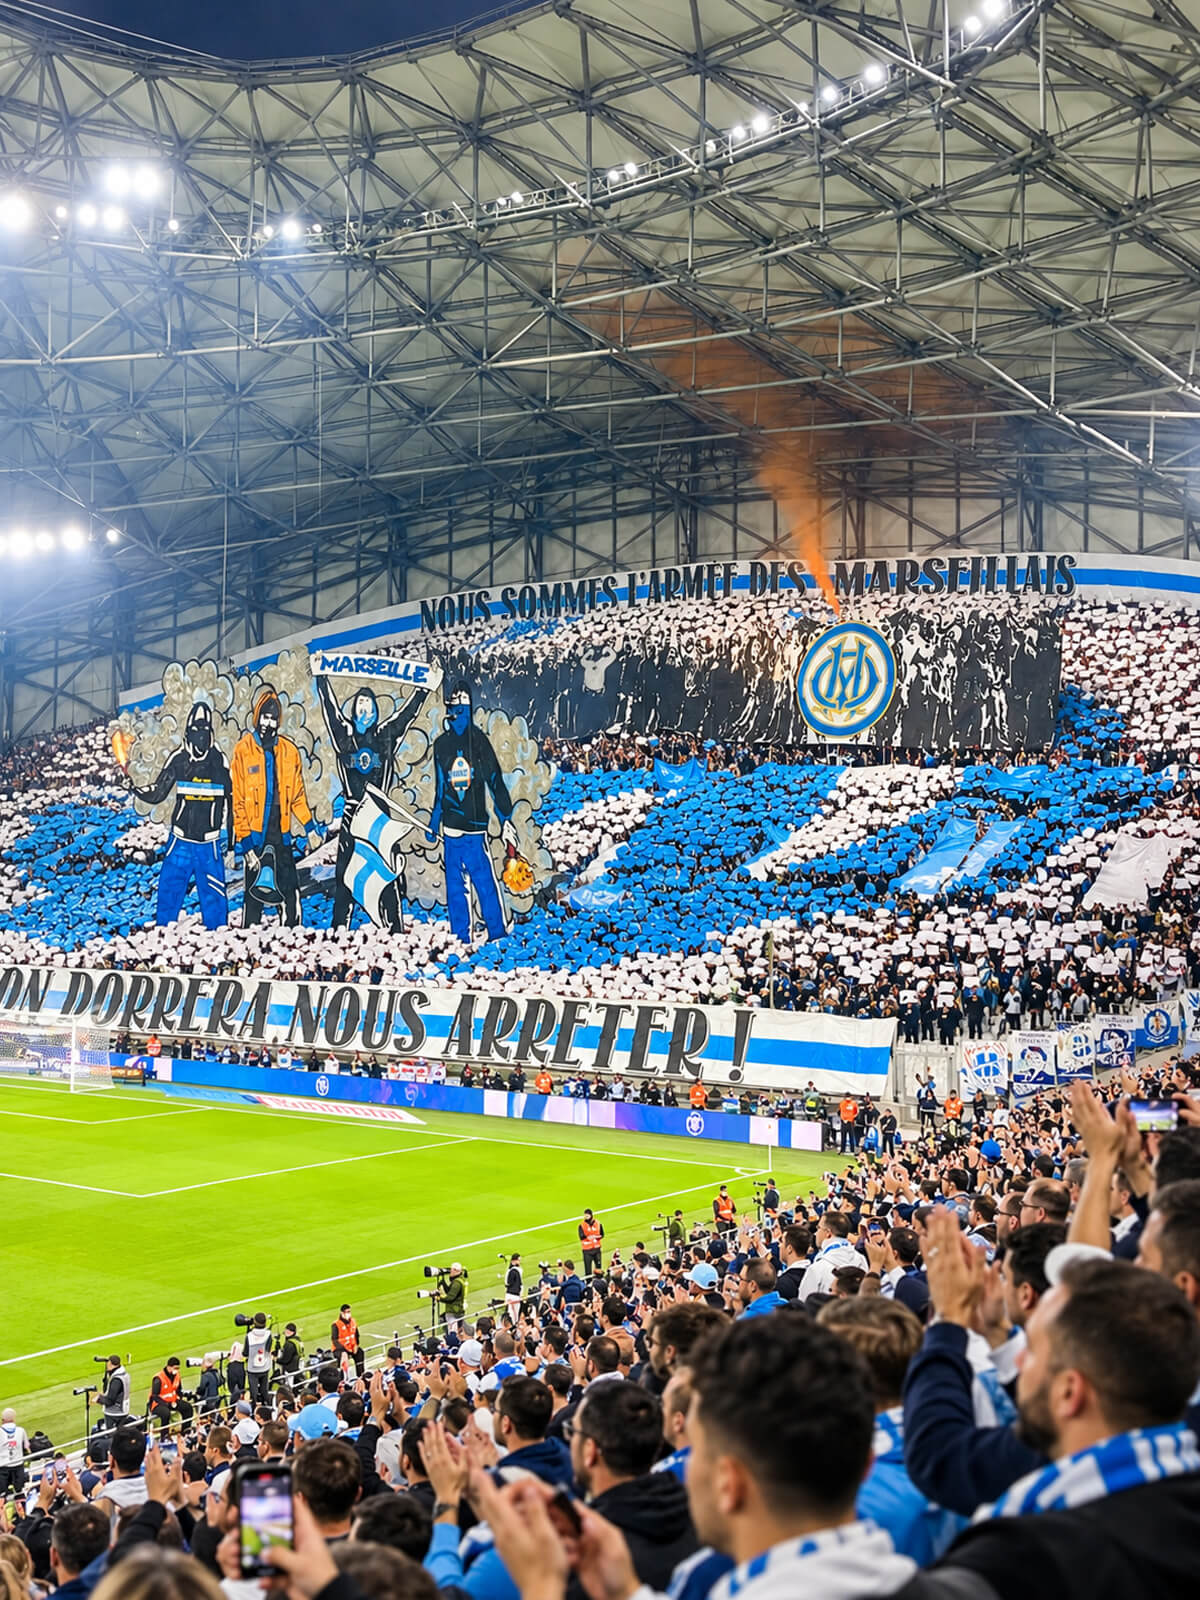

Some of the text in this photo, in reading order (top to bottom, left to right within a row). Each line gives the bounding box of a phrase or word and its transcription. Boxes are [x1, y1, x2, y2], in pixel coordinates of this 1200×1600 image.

[420, 590, 492, 634] NOUS
[501, 575, 619, 622] SOMMES
[749, 560, 807, 598] DES
[834, 554, 1077, 596] MARSEILLAIS
[319, 655, 430, 683] MARSEILLE
[285, 984, 430, 1053] NOUS
[441, 993, 712, 1079] ARRETER
